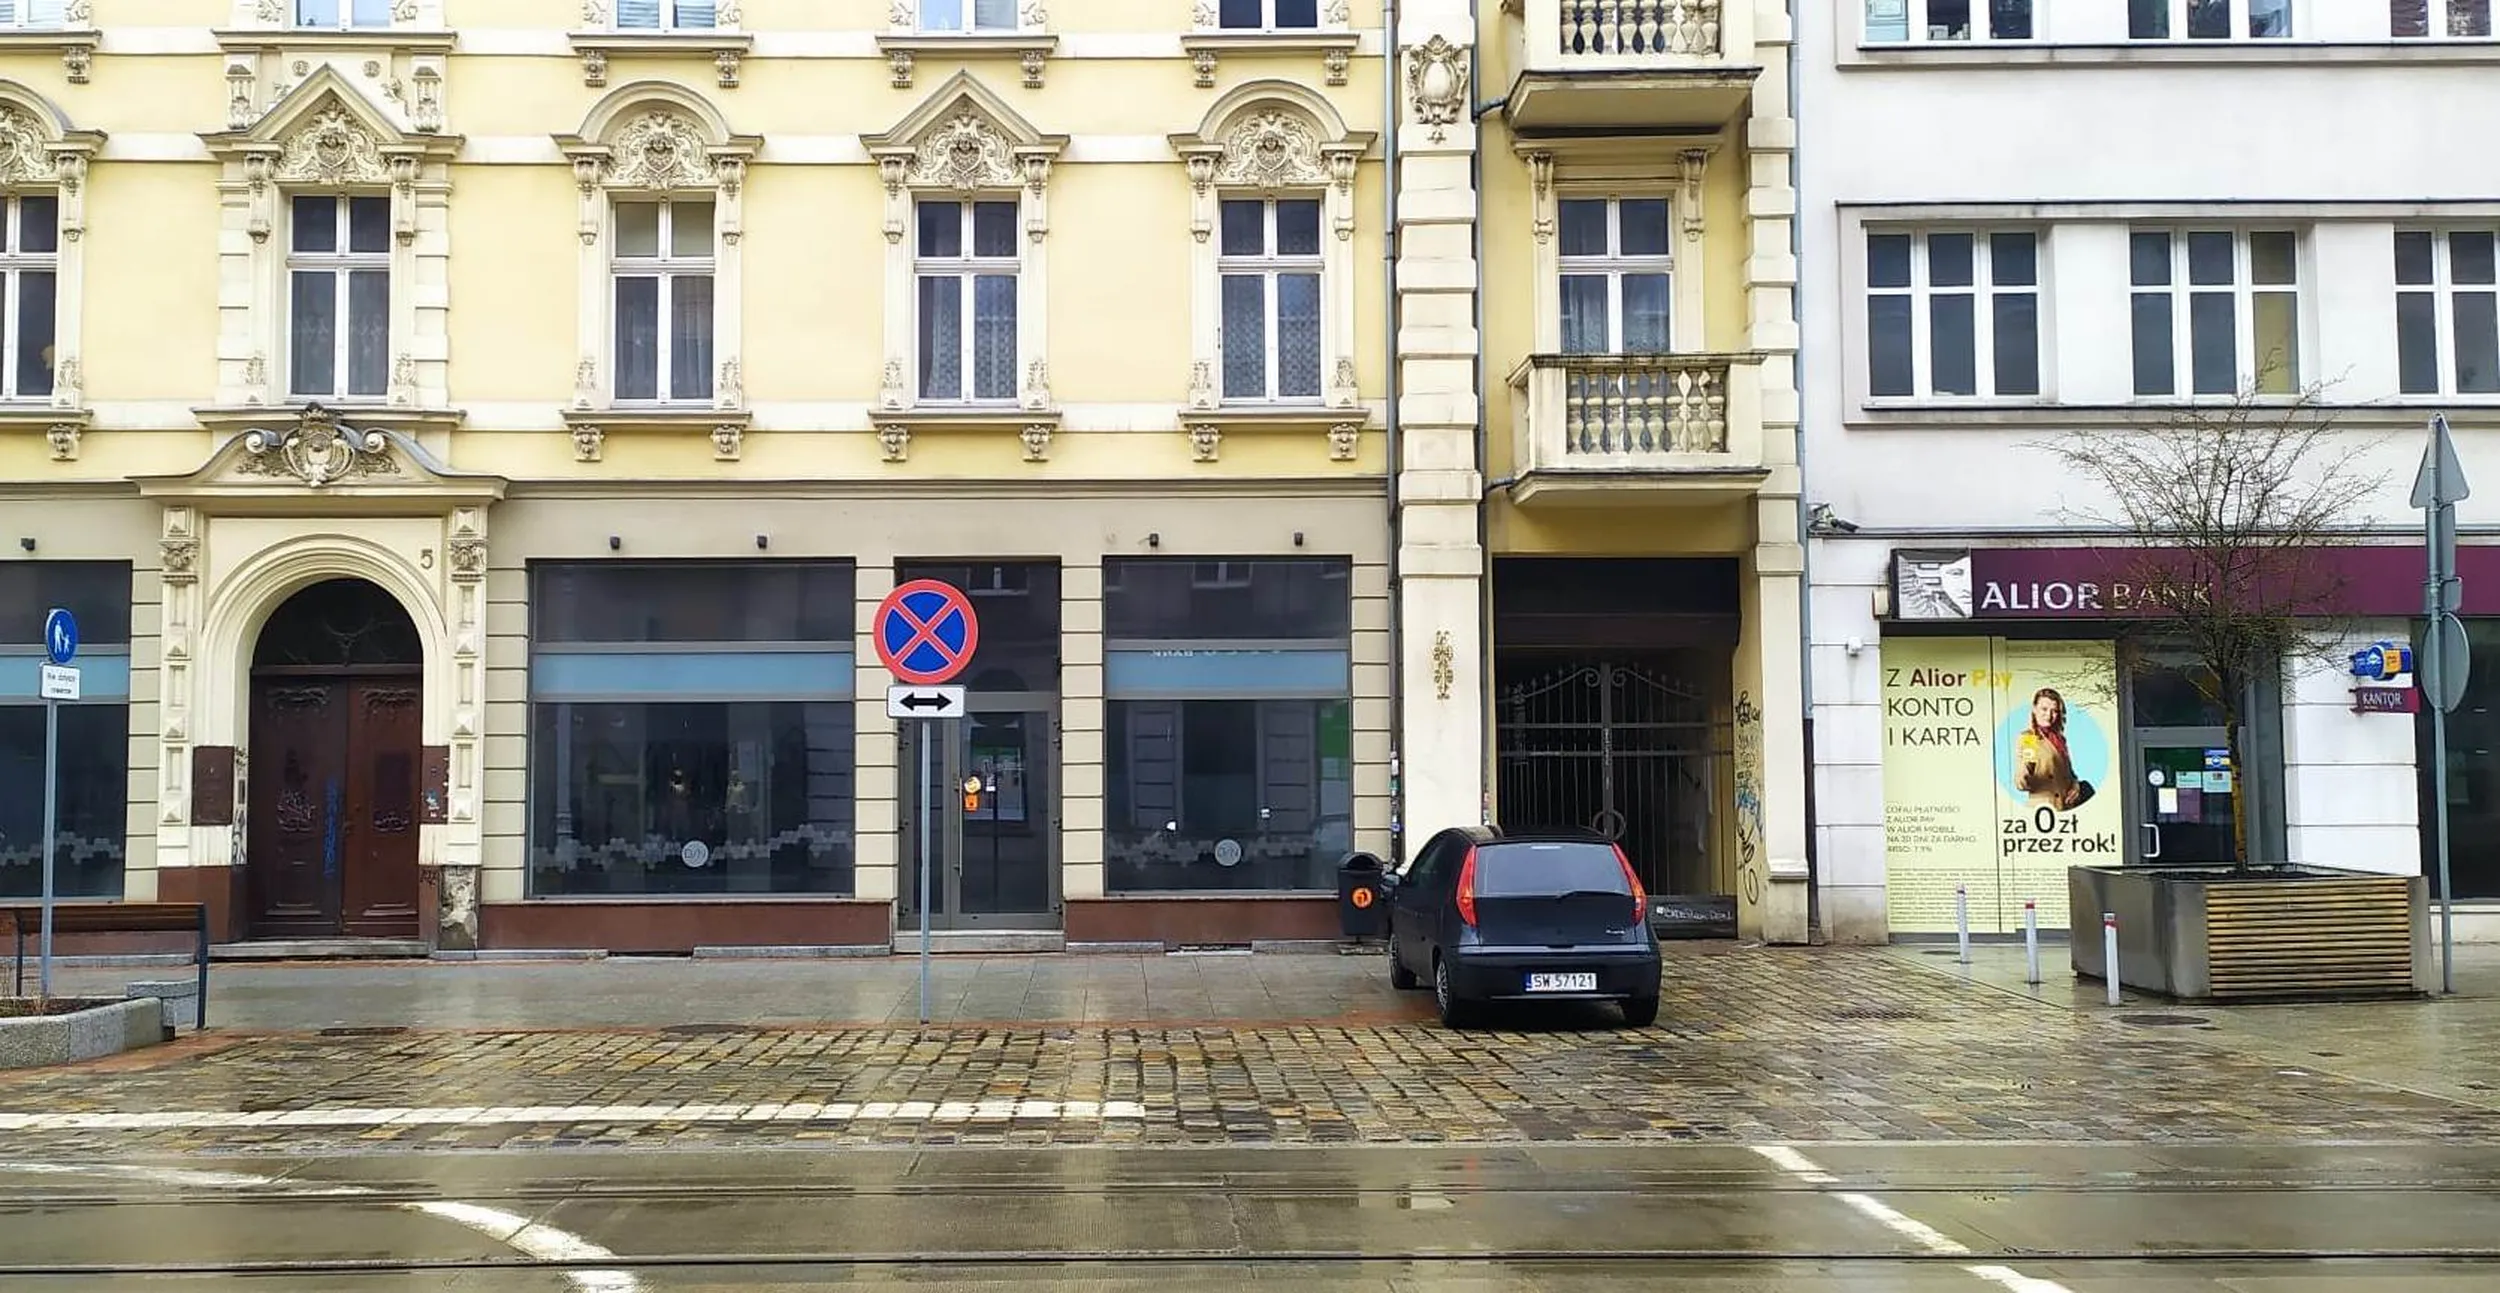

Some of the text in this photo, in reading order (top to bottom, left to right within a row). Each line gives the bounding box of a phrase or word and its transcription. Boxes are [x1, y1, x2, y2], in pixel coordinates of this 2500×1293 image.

[420, 548, 433, 570] 5
[1981, 582, 2103, 610] ALIOR
[1886, 668, 1901, 687] Z
[1909, 668, 1967, 687] Alior
[1888, 697, 1974, 717] KONTO
[2362, 692, 2403, 705] KANTOR
[1889, 727, 1981, 746] I KARTA
[2003, 806, 2078, 833] za 0 zł
[2003, 832, 2116, 857] przez rok!
[1533, 974, 1594, 988] SW 57121
